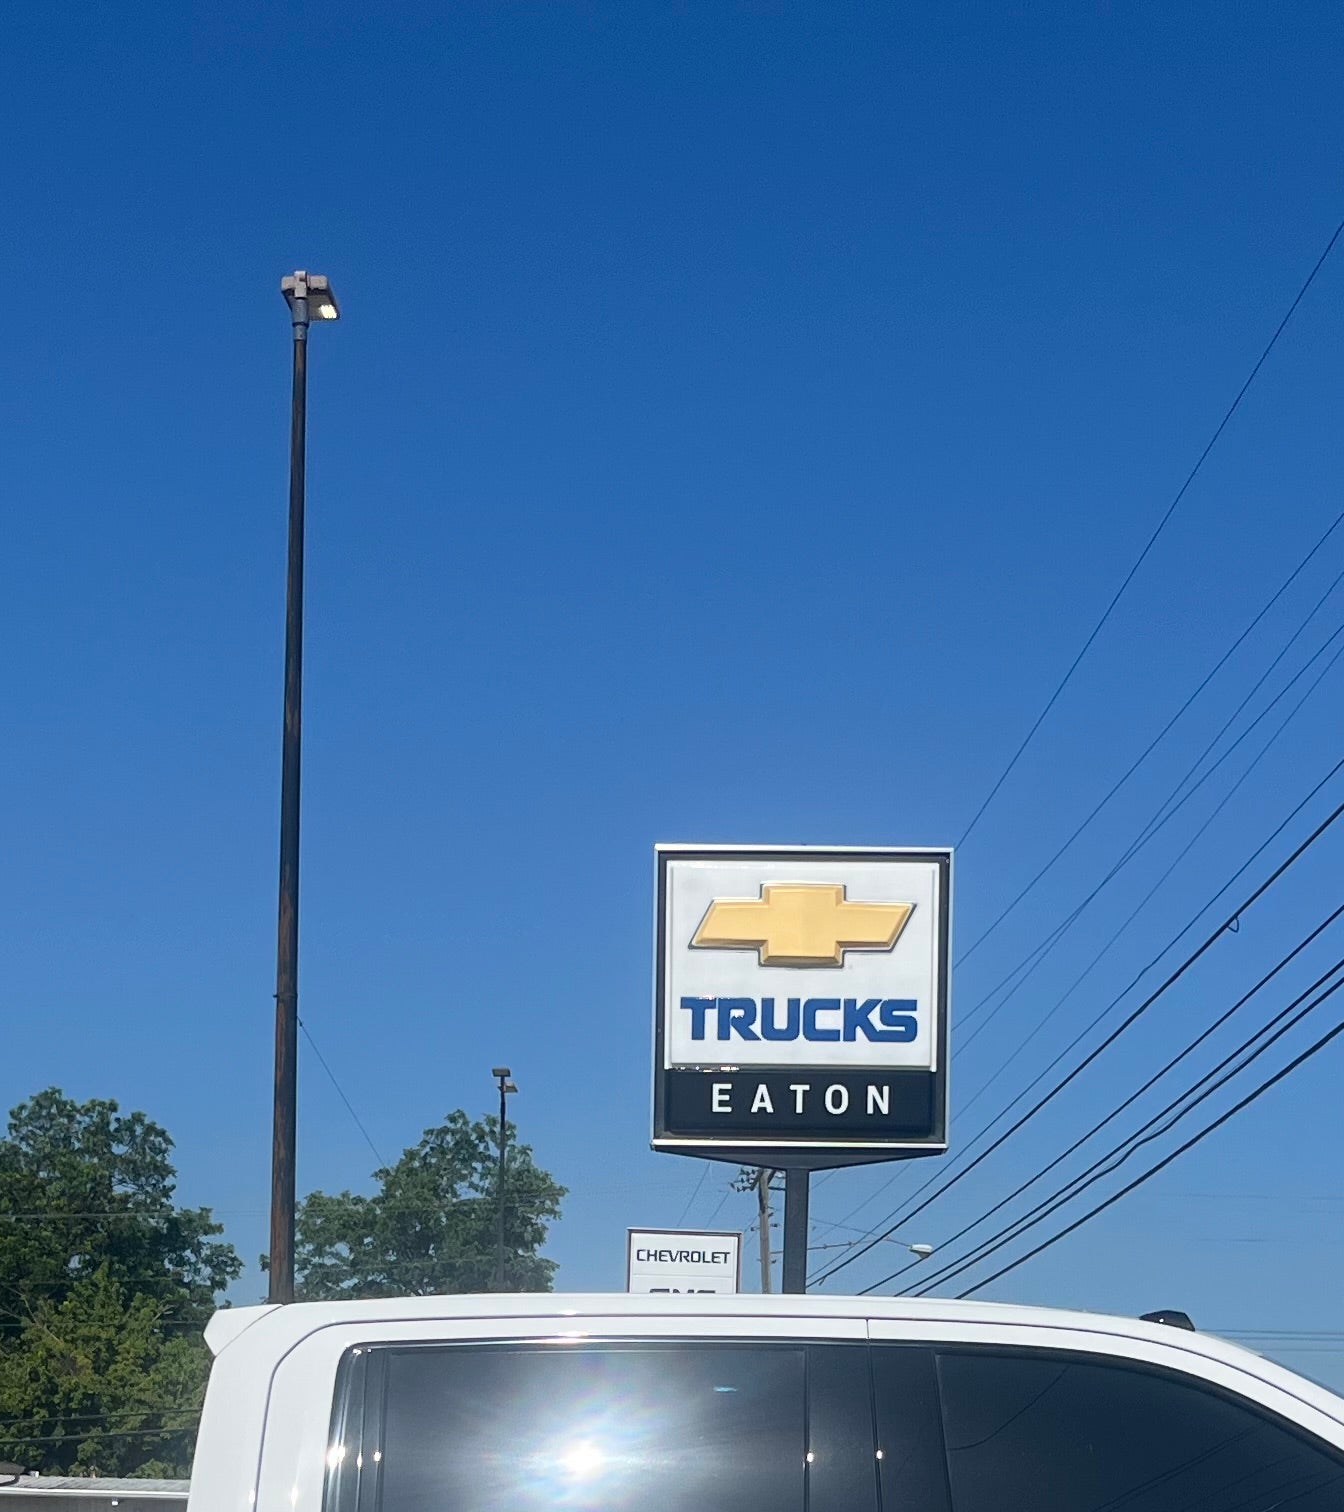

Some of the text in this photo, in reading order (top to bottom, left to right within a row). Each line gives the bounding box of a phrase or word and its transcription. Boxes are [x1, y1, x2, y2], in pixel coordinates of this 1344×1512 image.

[680, 996, 918, 1043] TRUCKS
[712, 1083, 889, 1115] EATON
[636, 1249, 730, 1264] CHEVROLET
